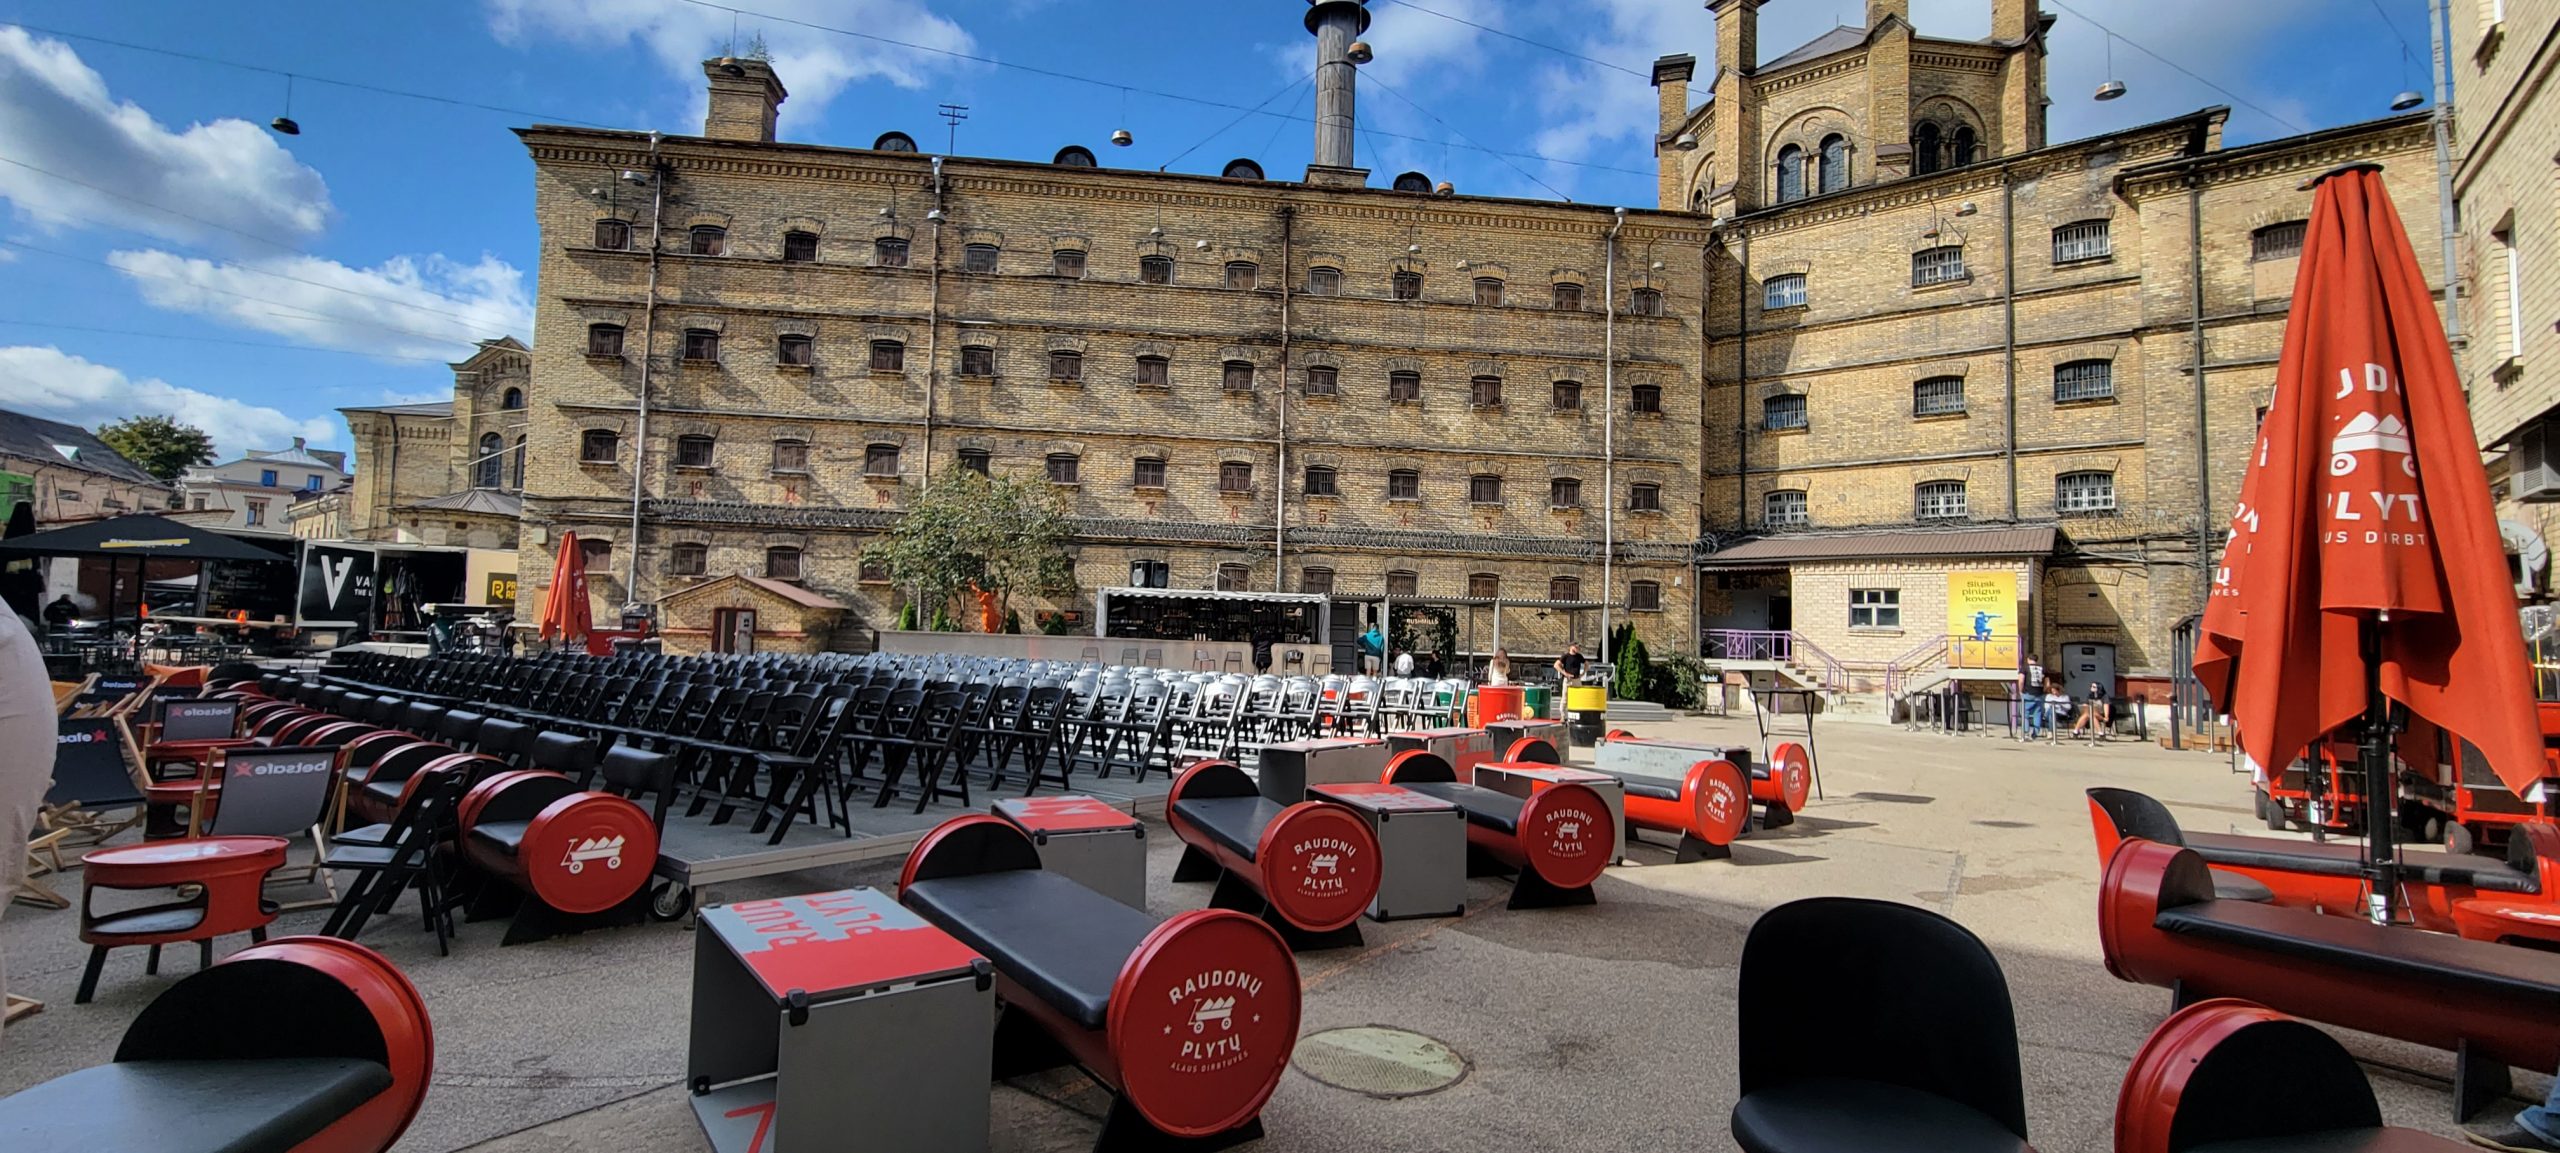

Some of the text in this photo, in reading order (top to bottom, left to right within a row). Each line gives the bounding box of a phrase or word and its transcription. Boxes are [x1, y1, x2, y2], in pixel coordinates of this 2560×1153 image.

[1319, 509, 1328, 523] 5
[2327, 491, 2420, 522] LYT
[1483, 516, 1493, 530] 3
[57, 730, 93, 744] safe
[1169, 970, 1262, 1005] RAUDONŲ
[1181, 1033, 1241, 1060] PLYTŲ
